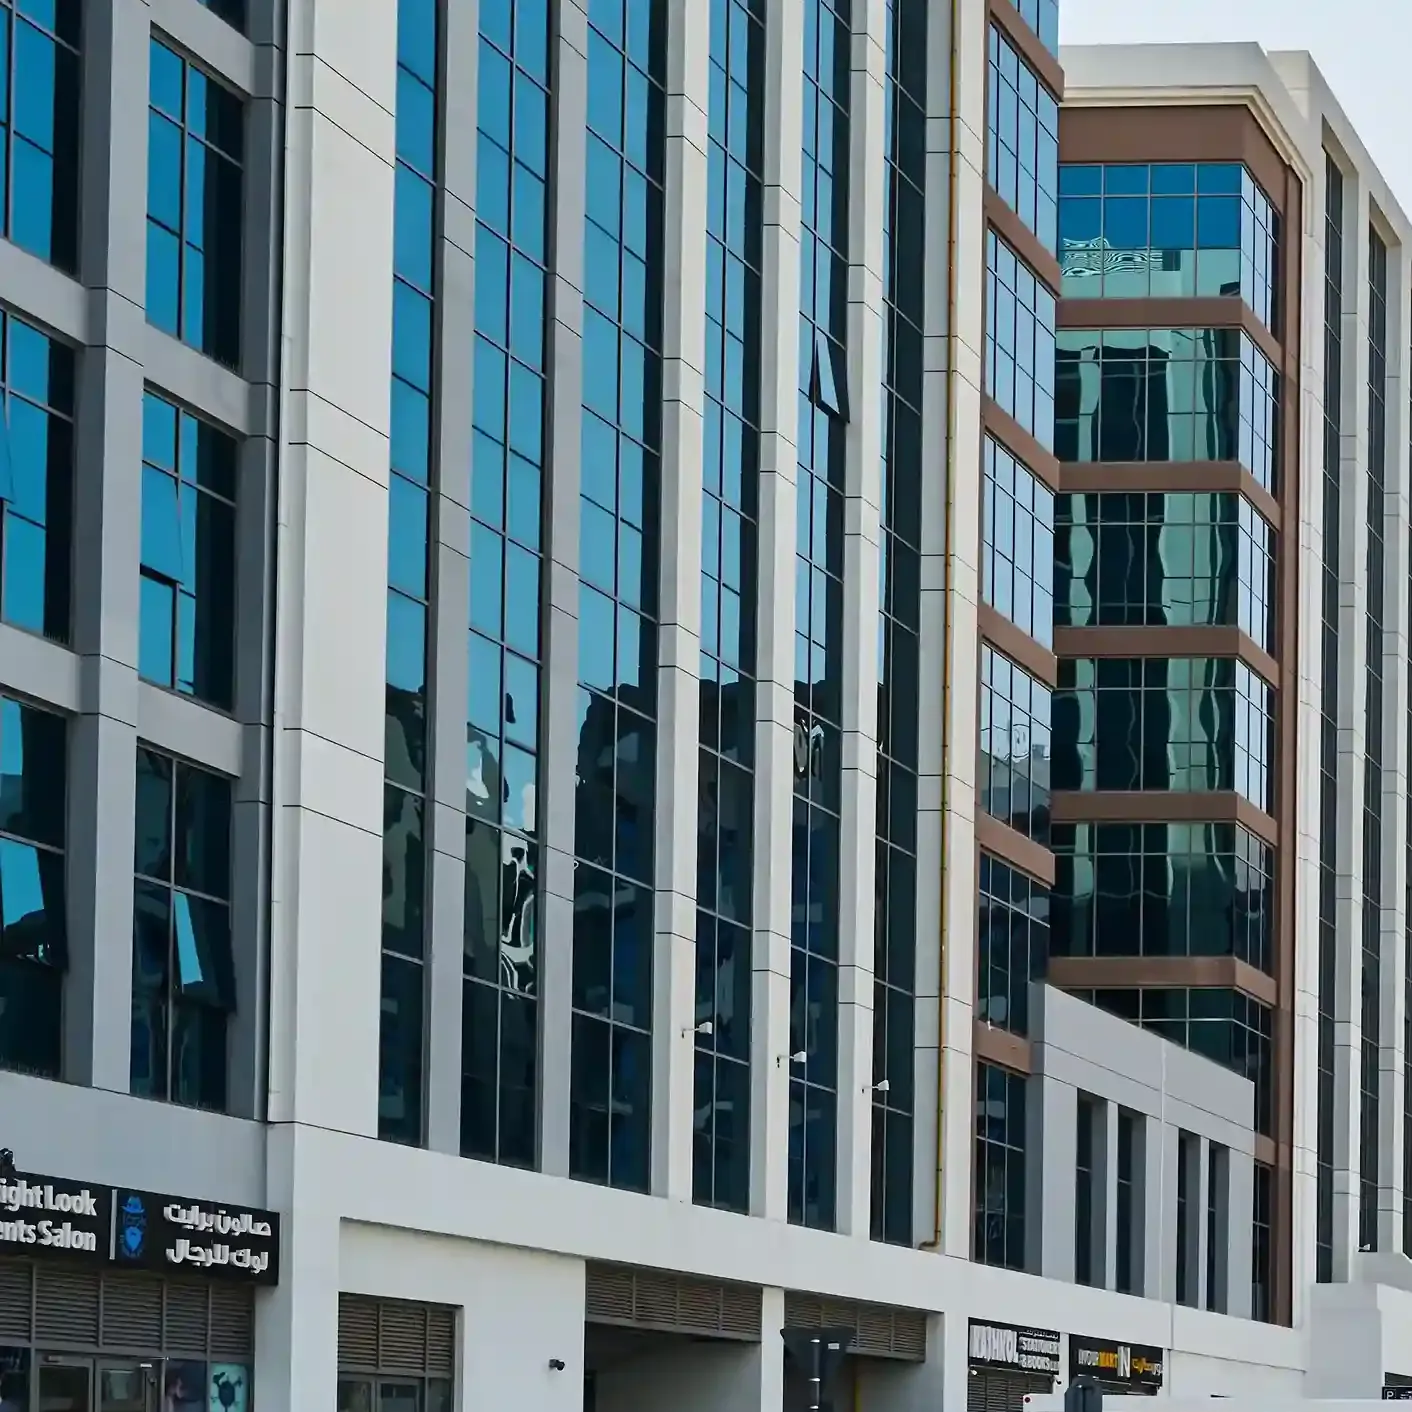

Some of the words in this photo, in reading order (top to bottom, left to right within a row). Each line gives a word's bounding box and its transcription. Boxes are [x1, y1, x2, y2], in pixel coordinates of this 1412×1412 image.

[44, 1185, 97, 1216] Look
[37, 1220, 97, 1252] Salon
[214, 1210, 272, 1237] صالون
[166, 1238, 229, 1267] للرجال
[230, 1248, 269, 1274] لوك
